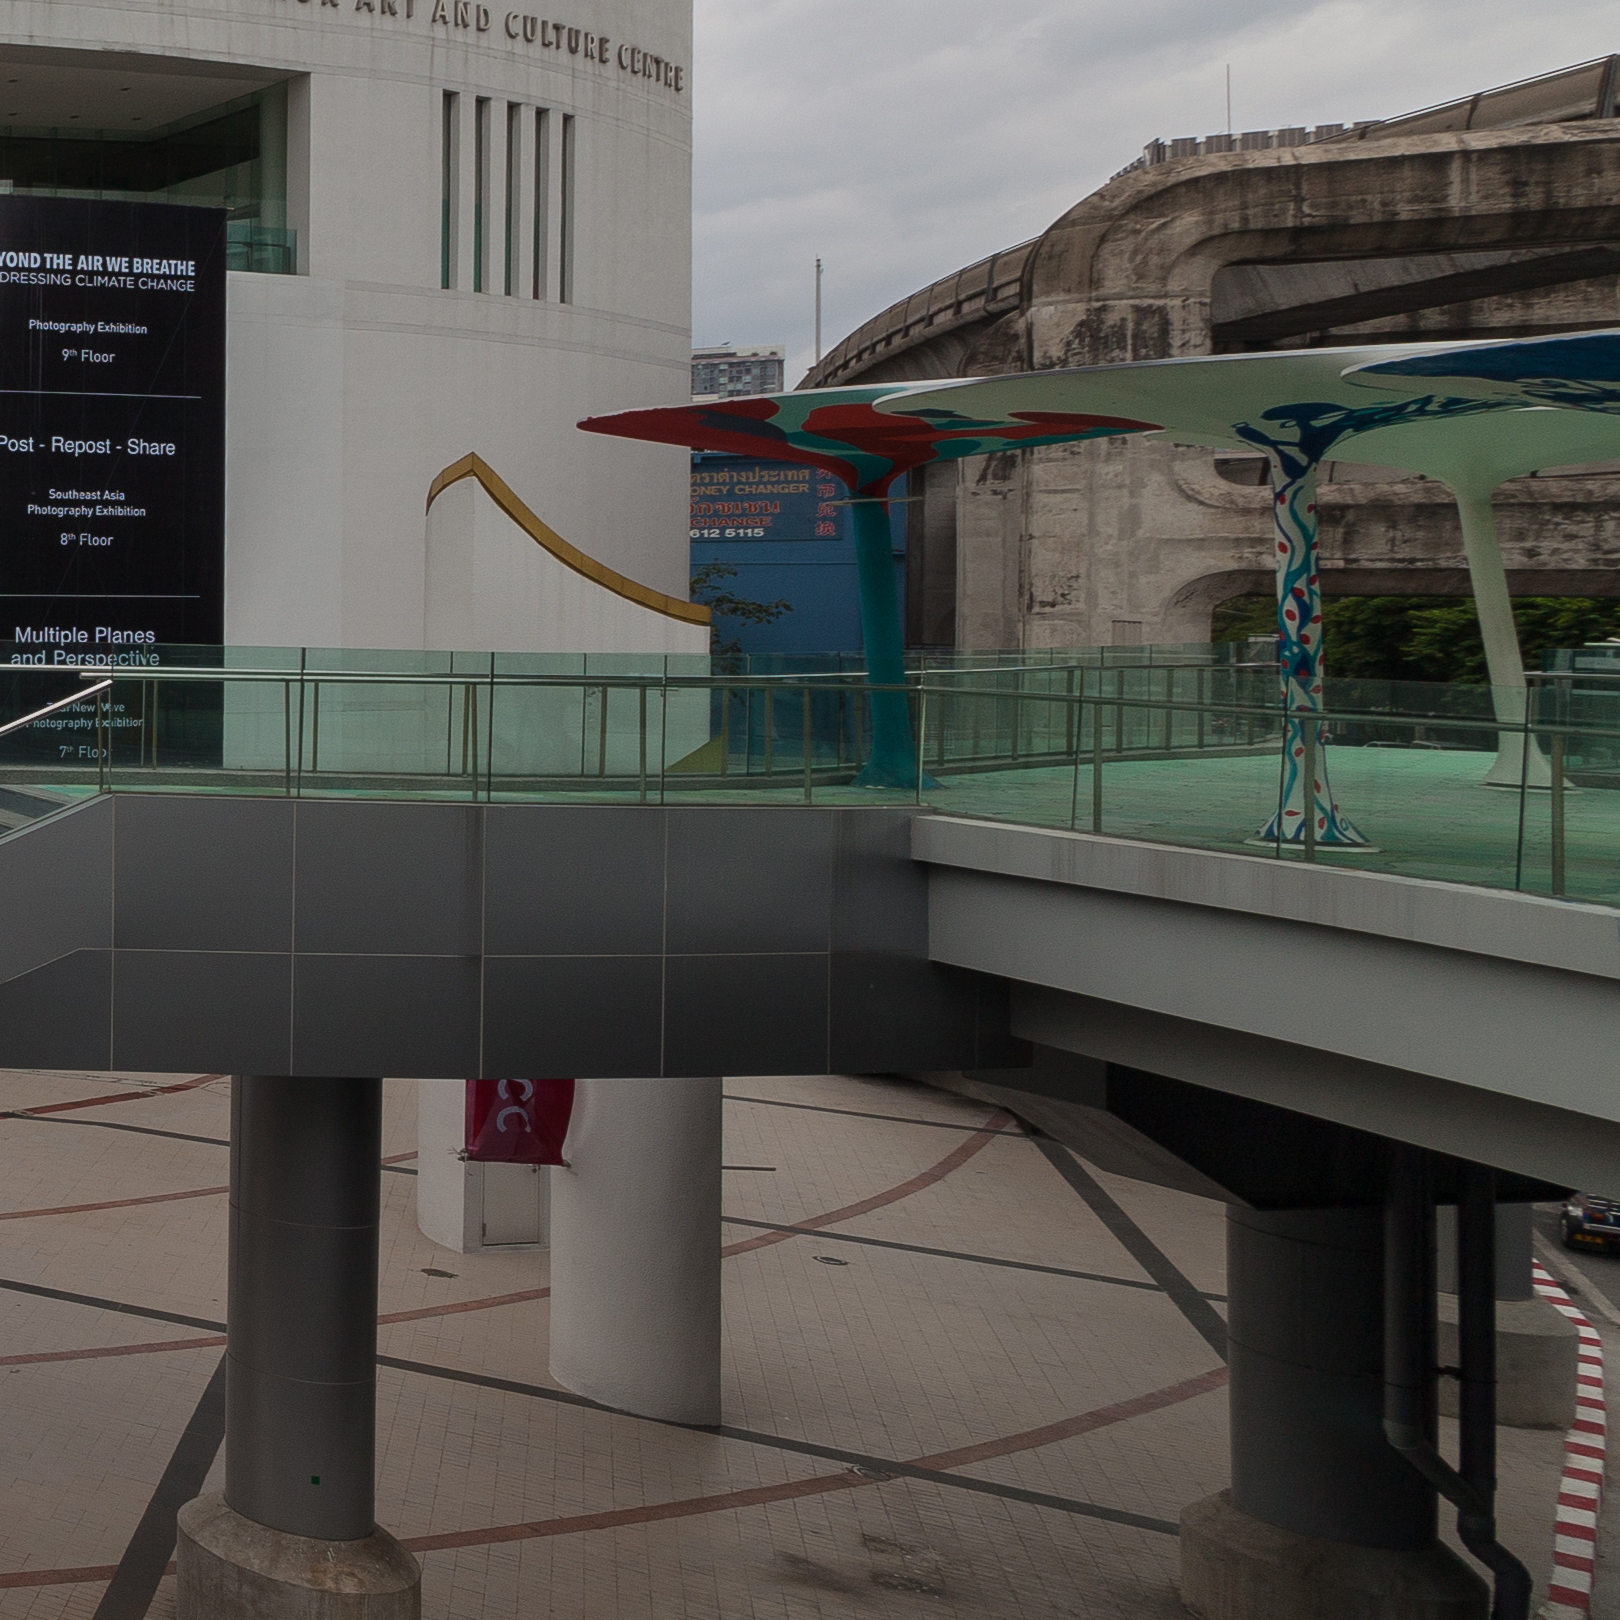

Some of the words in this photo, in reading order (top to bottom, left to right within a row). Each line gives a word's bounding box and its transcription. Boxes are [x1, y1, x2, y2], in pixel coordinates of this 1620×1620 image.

[504, 11, 610, 65] CULTURE
[617, 43, 684, 92] CENTRE
[44, 253, 73, 270] THE
[77, 255, 103, 271] AIR
[106, 256, 129, 273] WE
[133, 258, 195, 276] BREATHE
[75, 274, 135, 289] CLIMATE
[138, 277, 195, 292] CHANGE
[29, 319, 96, 335] Photography
[97, 321, 148, 334] Exhibition
[62, 348, 78, 362] 9th
[81, 349, 116, 363] Floor
[51, 436, 111, 457] Repost
[127, 438, 176, 456] Share
[48, 489, 101, 500] Southeast
[102, 490, 125, 501] Asia
[690, 485, 730, 496] ONEY
[734, 483, 810, 495] CHANGER
[27, 504, 94, 518] Photography
[95, 505, 146, 517] Exhibition
[690, 516, 772, 527] CHANGE
[60, 533, 76, 546] 8th
[79, 533, 114, 546] Floor
[725, 528, 764, 538] 5115
[15, 626, 88, 646] Multiple
[95, 626, 155, 644] Planes
[11, 650, 46, 666] and
[53, 650, 160, 666] Perspective
[72, 702, 96, 712] New
[101, 703, 125, 712] Wve
[496, 1078, 533, 1133] CC
